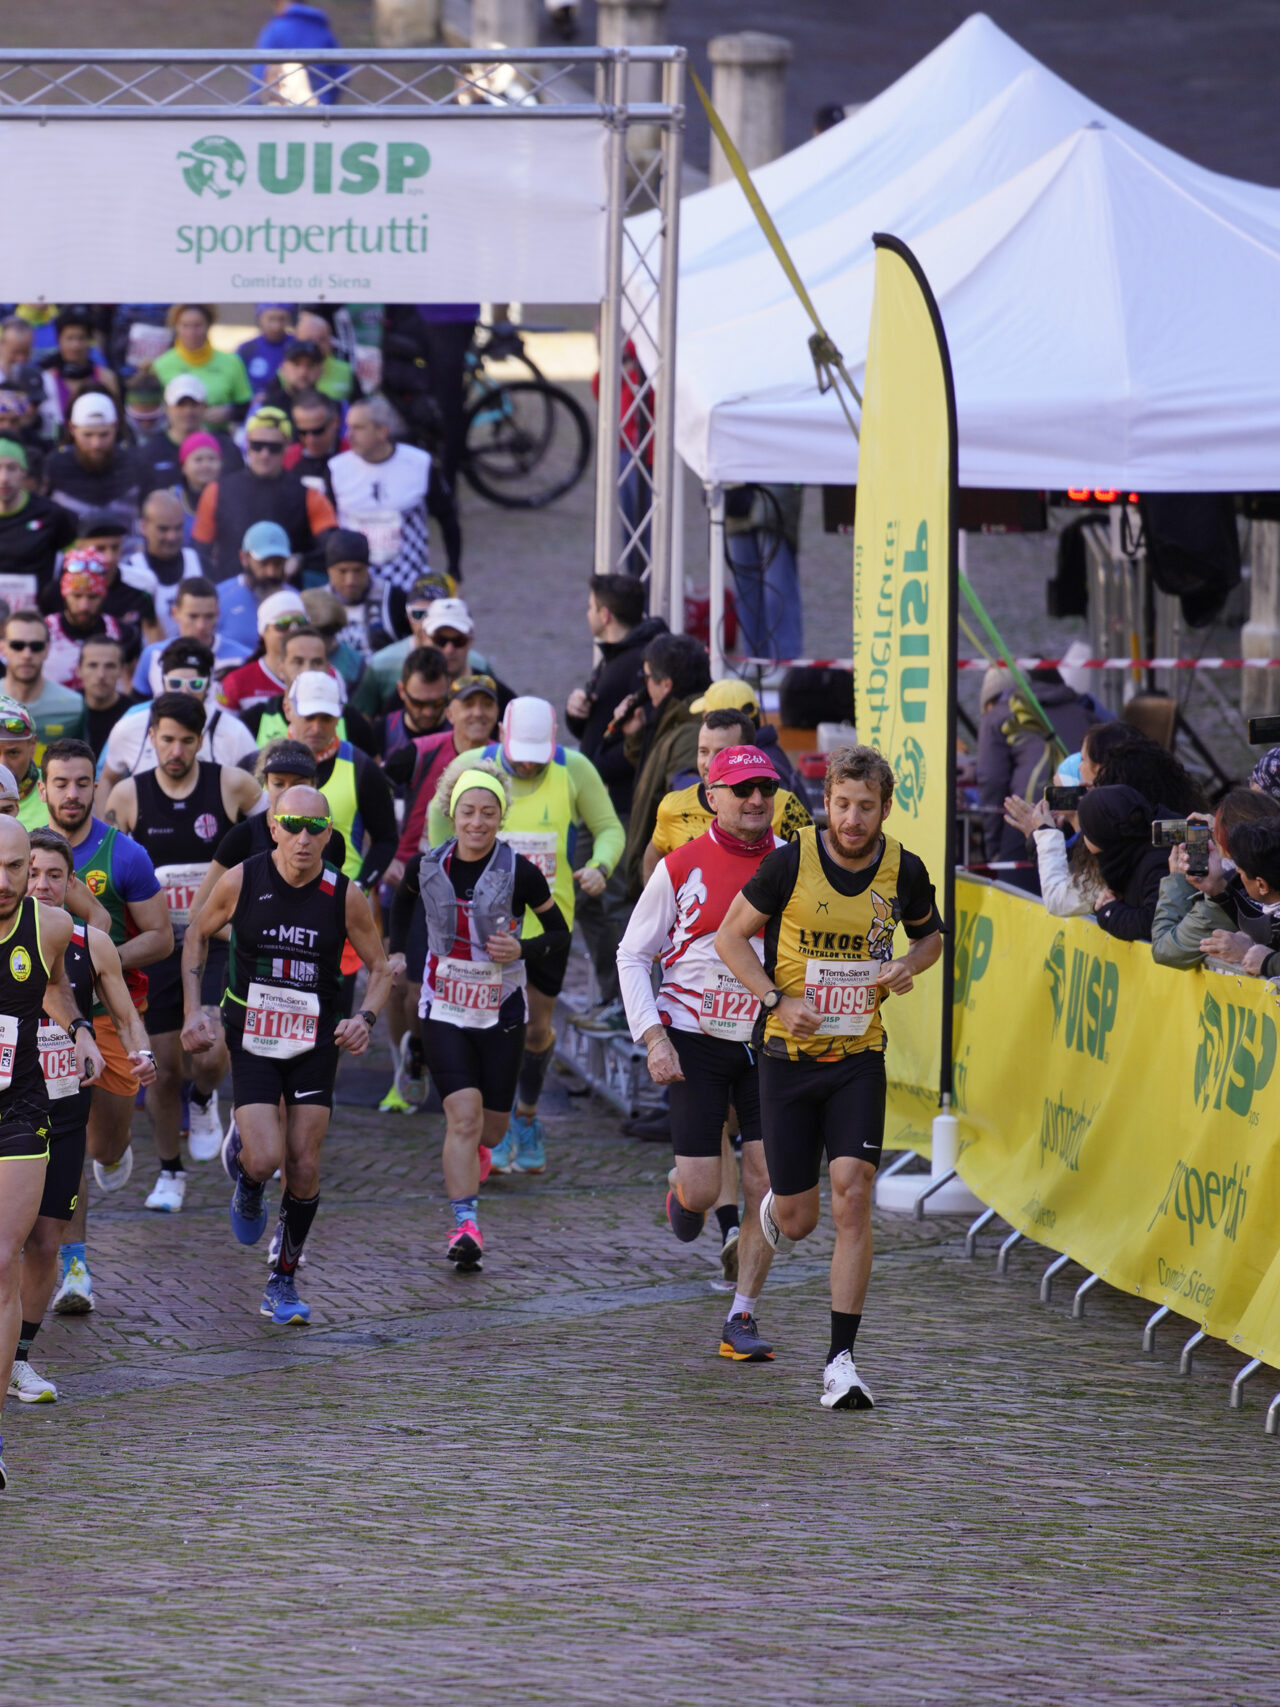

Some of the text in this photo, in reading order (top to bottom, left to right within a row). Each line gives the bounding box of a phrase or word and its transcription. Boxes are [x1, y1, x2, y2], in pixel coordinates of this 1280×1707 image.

[257, 141, 432, 195] UISP
[175, 213, 429, 265] sportpertutti
[231, 273, 372, 289] Comitato di Siena
[278, 924, 319, 949] MET
[799, 929, 864, 951] LYKOS
[798, 946, 862, 960] TRIATHLON TEAM
[445, 979, 490, 1009] 1078
[714, 991, 761, 1021] 1227
[817, 985, 868, 1014] 1099
[257, 1009, 306, 1040] 1104
[717, 1020, 737, 1029] UISP
[260, 1037, 279, 1046] UISP
